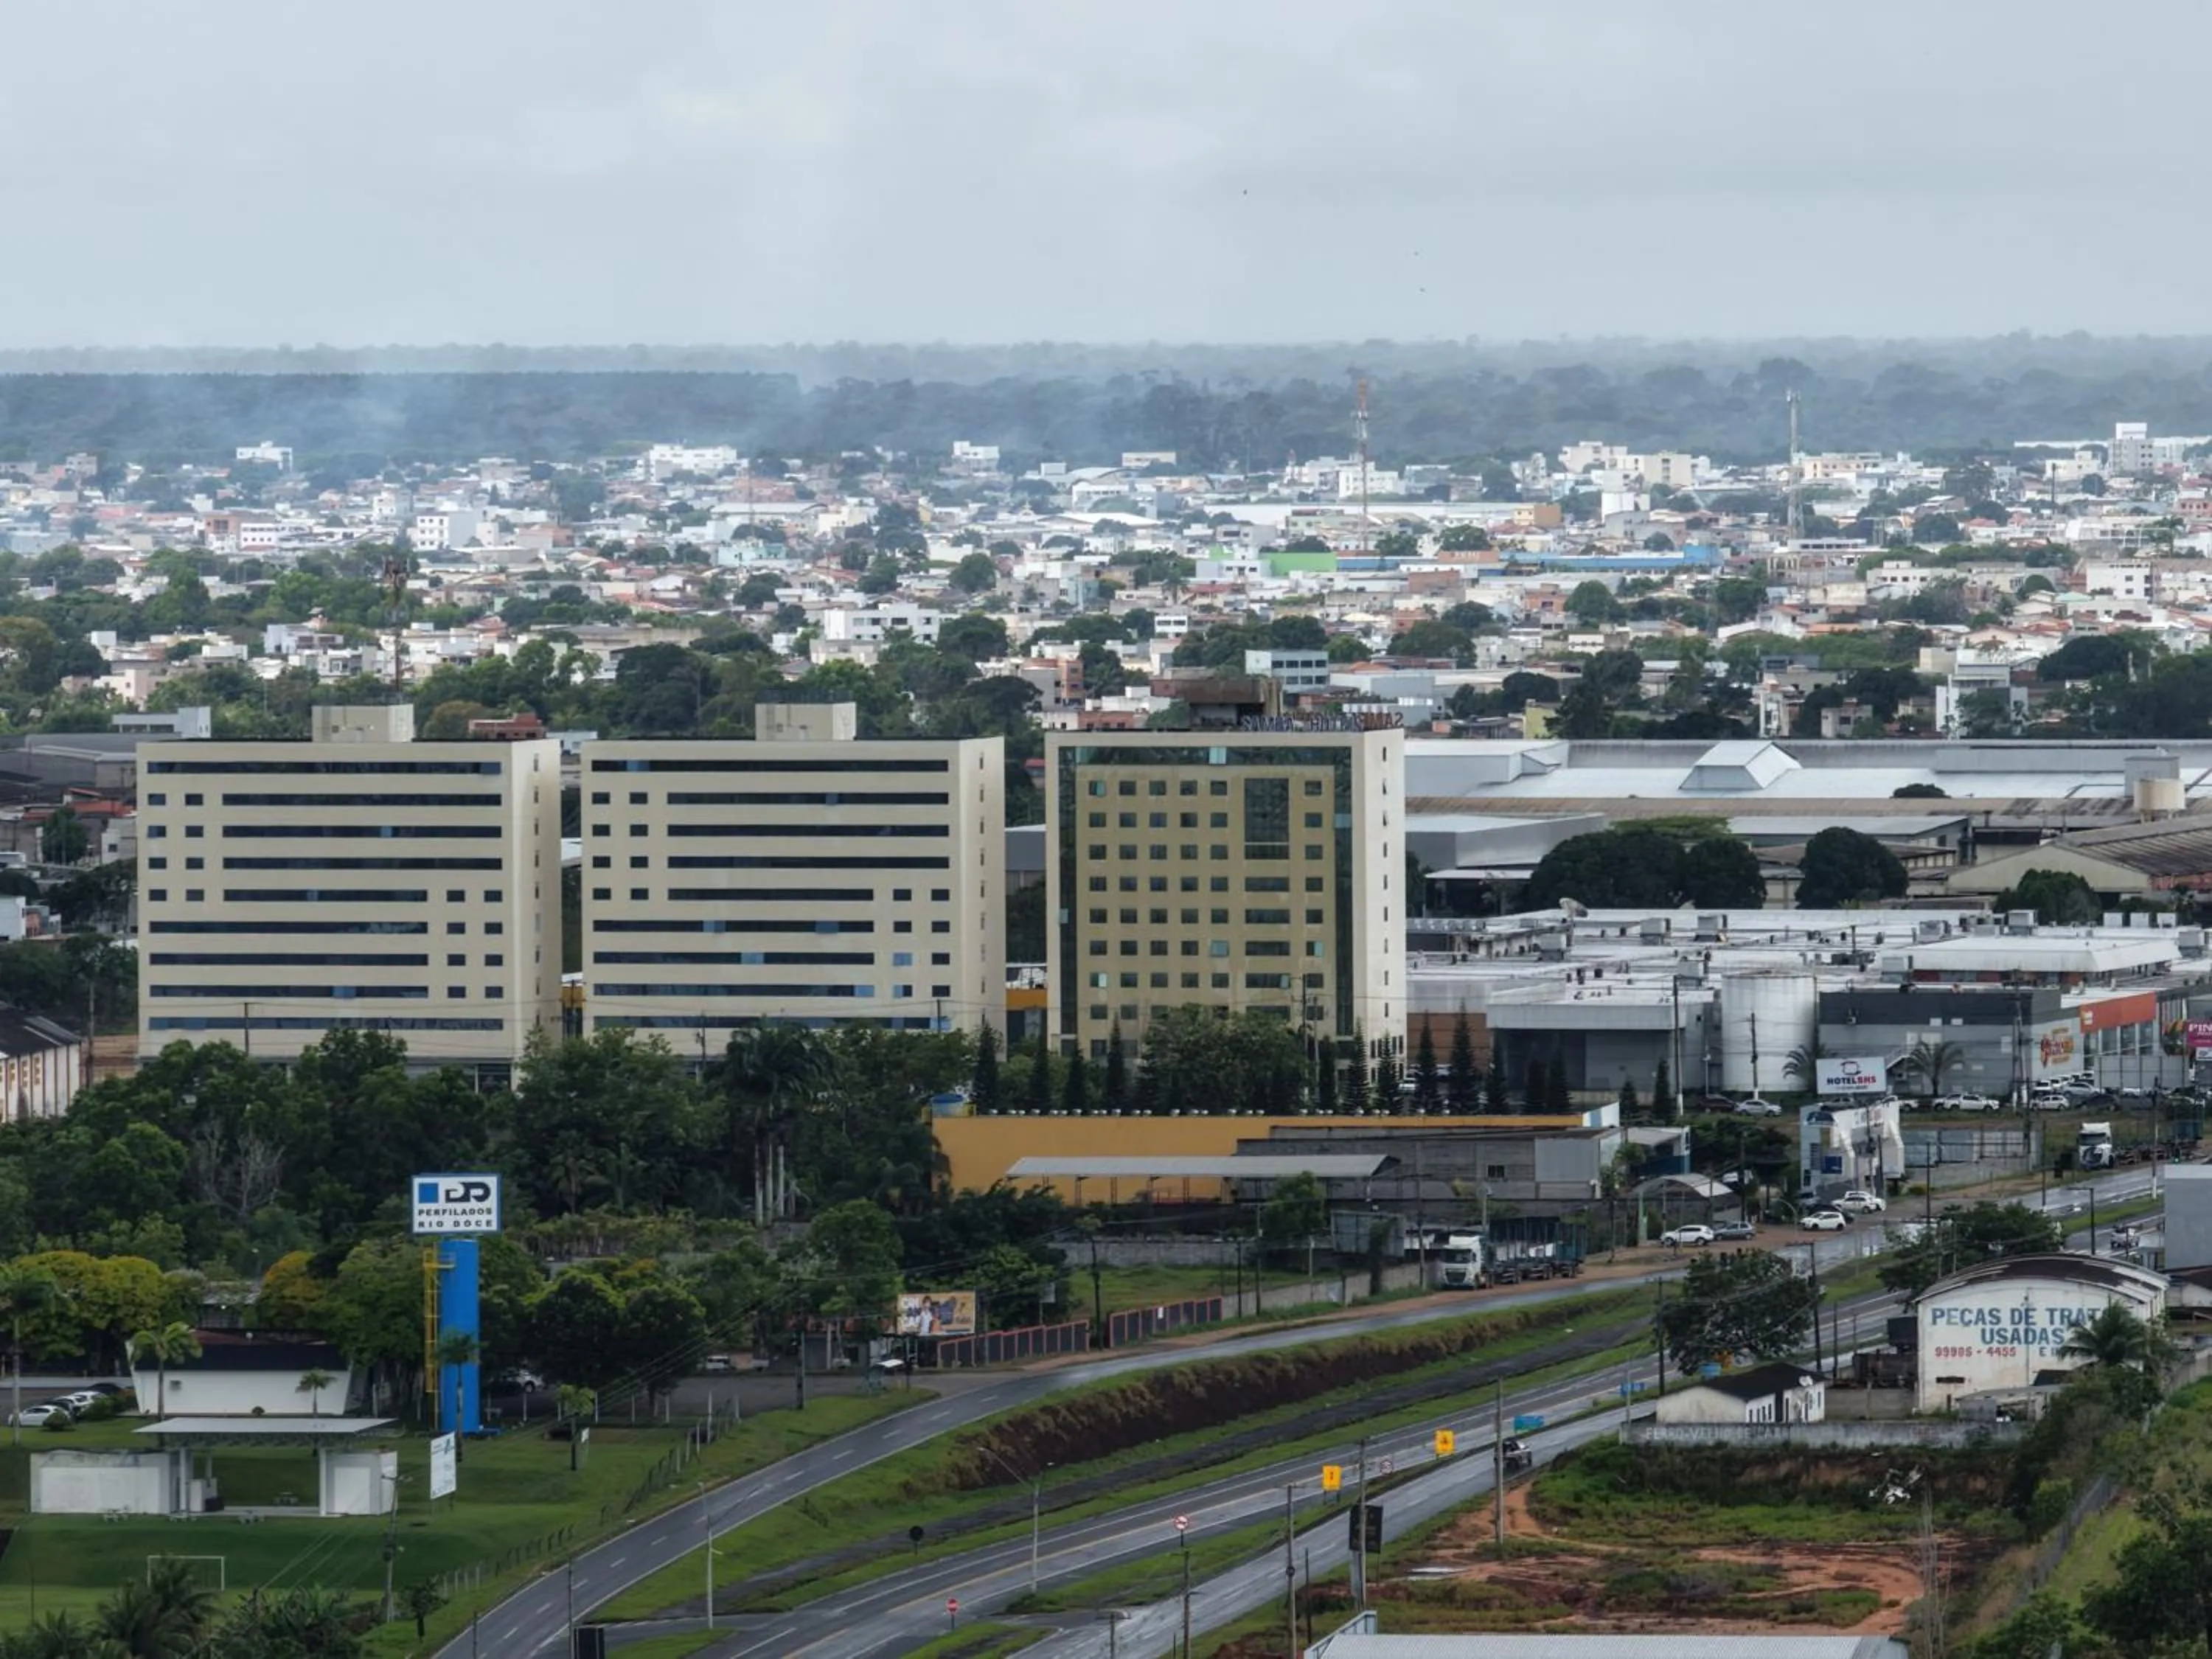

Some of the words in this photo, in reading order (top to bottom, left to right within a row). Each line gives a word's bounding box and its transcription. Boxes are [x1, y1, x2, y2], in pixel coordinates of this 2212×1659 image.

[418, 1207, 493, 1216] PERFILADOS
[1931, 1307, 2001, 1326] PEÇAS
[2010, 1307, 2037, 1326] DE
[2045, 1307, 2102, 1326] TRAT
[1980, 1328, 2065, 1346] USADAS
